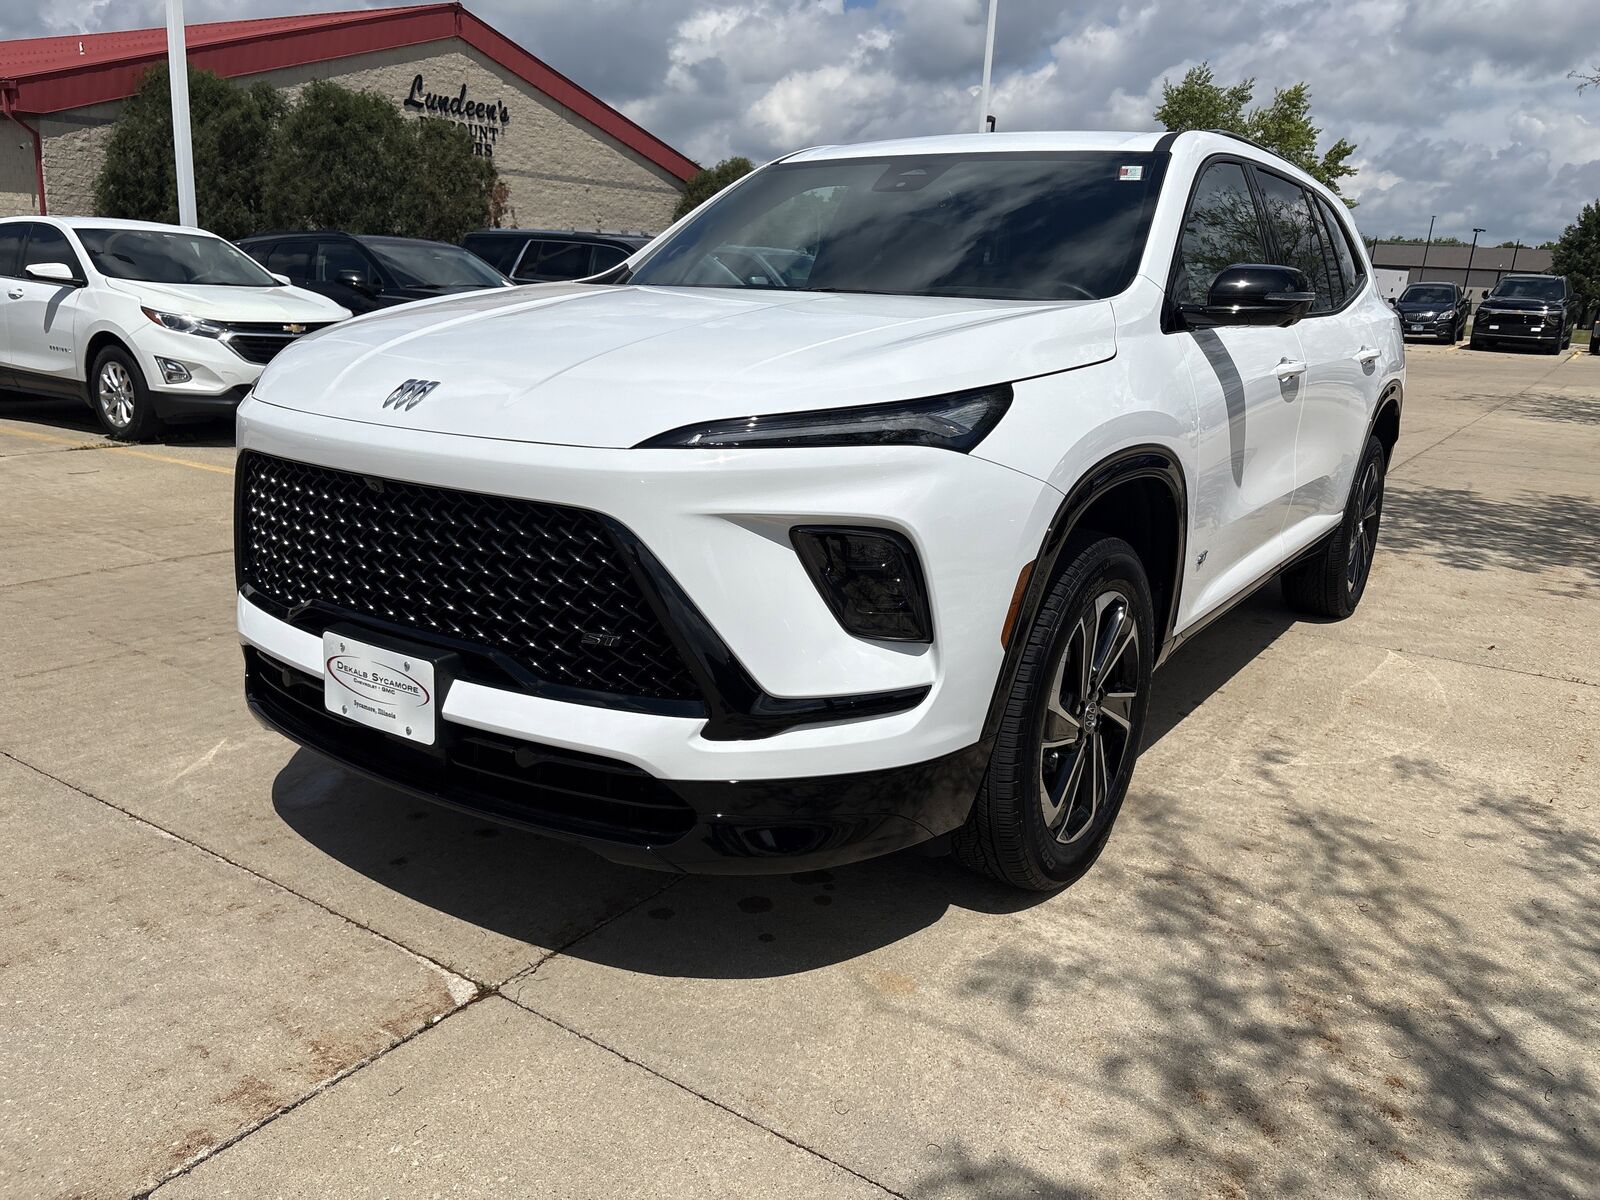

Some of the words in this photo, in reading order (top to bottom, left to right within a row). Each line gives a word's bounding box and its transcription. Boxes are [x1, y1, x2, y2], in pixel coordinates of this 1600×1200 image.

[404, 74, 509, 122] Lundeen's
[381, 687, 396, 695] GMC
[353, 699, 377, 714] Sycamore,
[377, 708, 396, 719] Illinois
